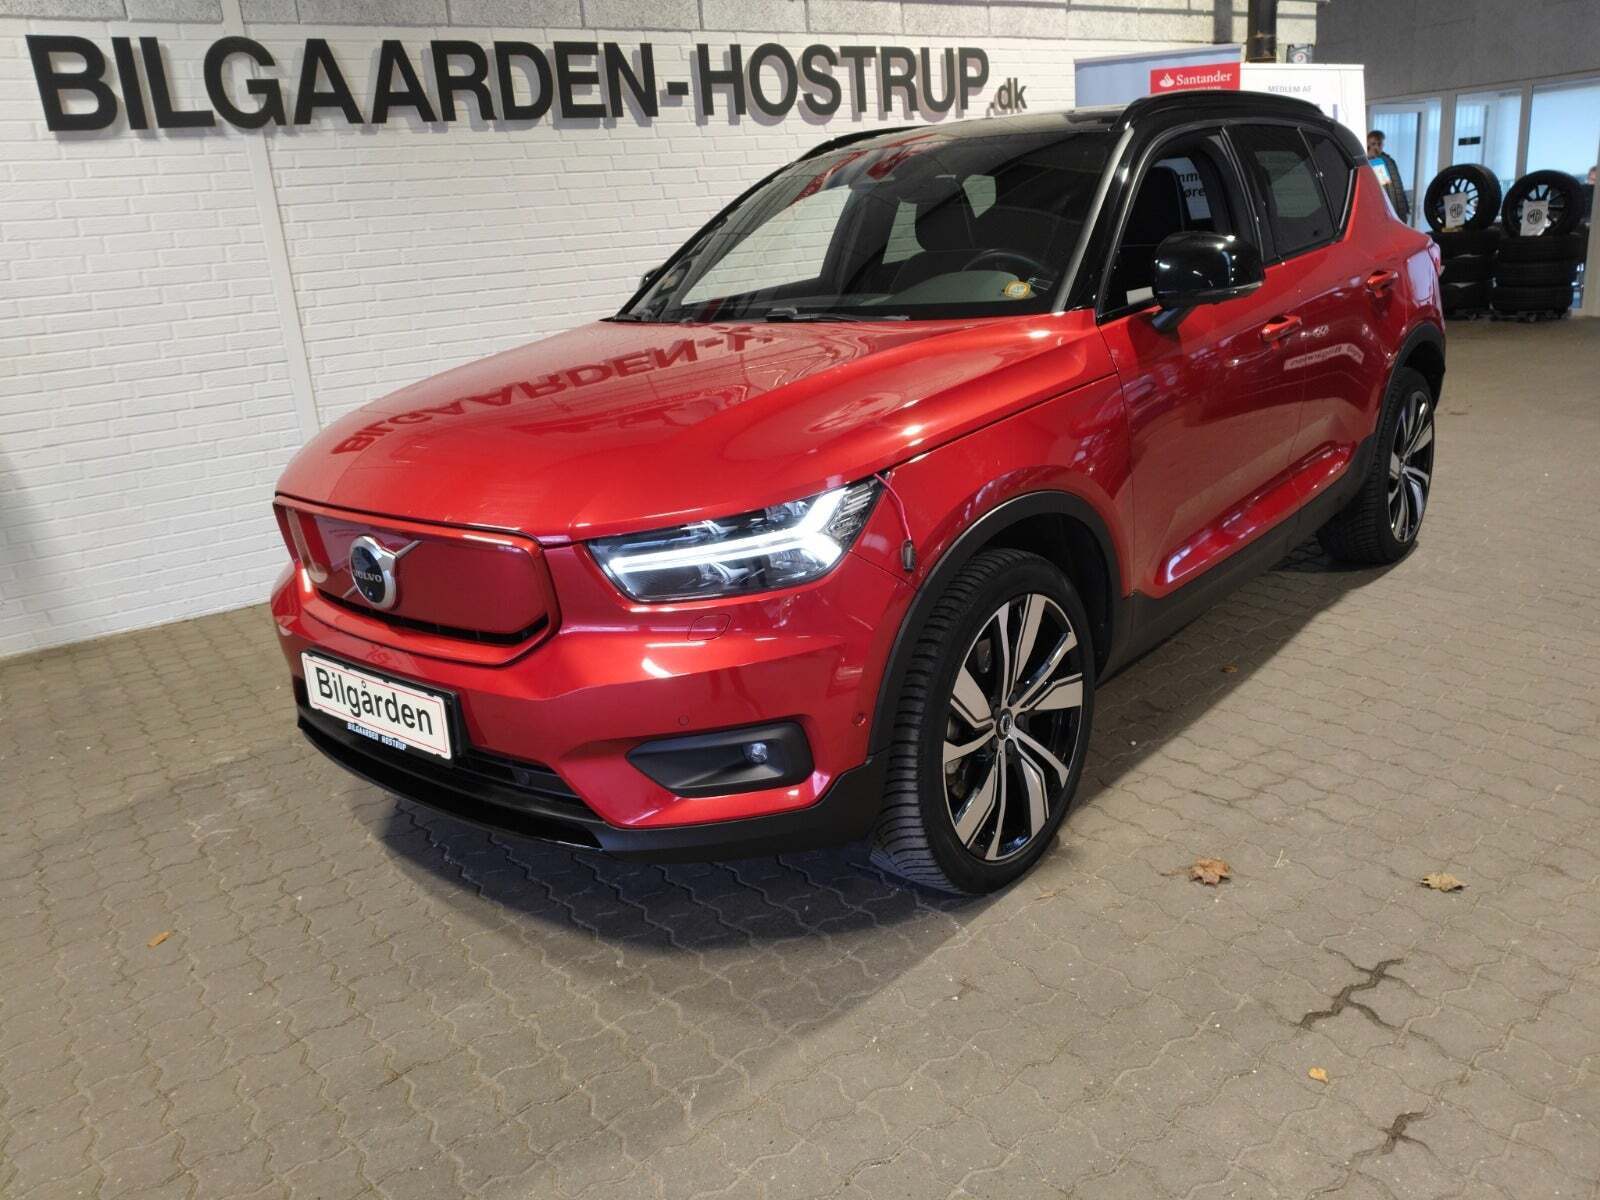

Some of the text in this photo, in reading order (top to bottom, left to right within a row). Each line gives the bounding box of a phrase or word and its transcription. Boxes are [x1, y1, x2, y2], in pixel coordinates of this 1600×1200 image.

[1176, 70, 1233, 86] Santander
[353, 569, 382, 583] VOLVO
[315, 667, 433, 735] Bilgården
